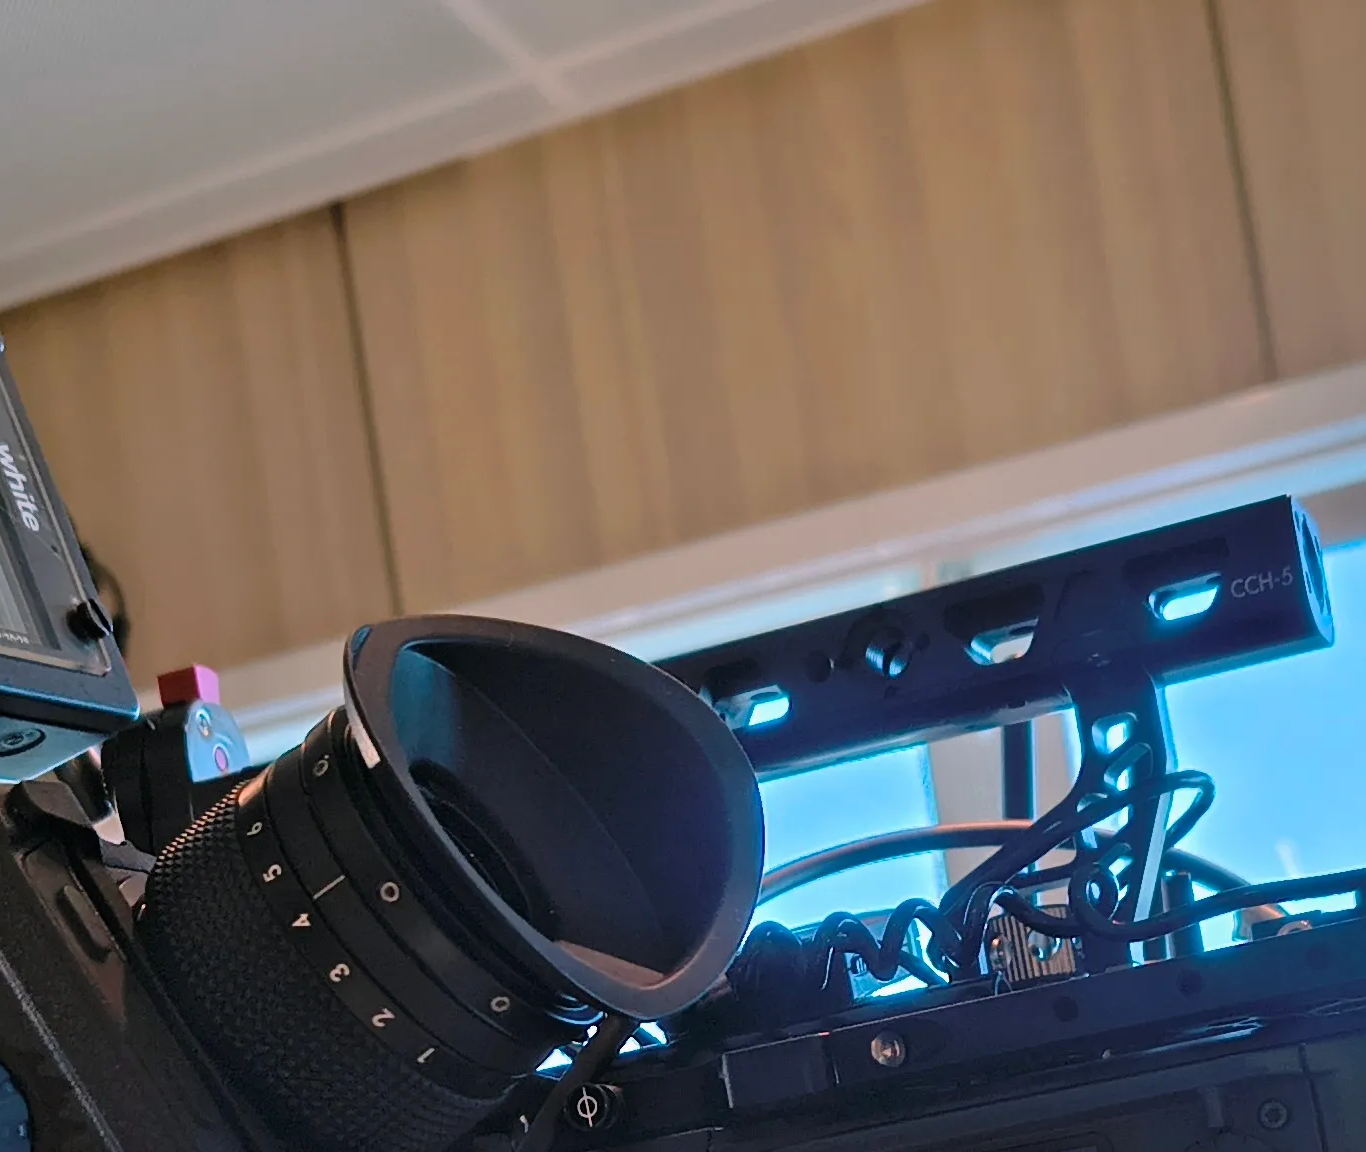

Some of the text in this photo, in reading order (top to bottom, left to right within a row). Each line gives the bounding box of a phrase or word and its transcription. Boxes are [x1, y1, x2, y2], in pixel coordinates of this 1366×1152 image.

[1230, 565, 1294, 598] CCH-5
[263, 864, 282, 882] 5
[292, 913, 311, 927] 4
[329, 963, 350, 982] 3
[371, 1008, 395, 1027] 2
[417, 1047, 435, 1063] 1
